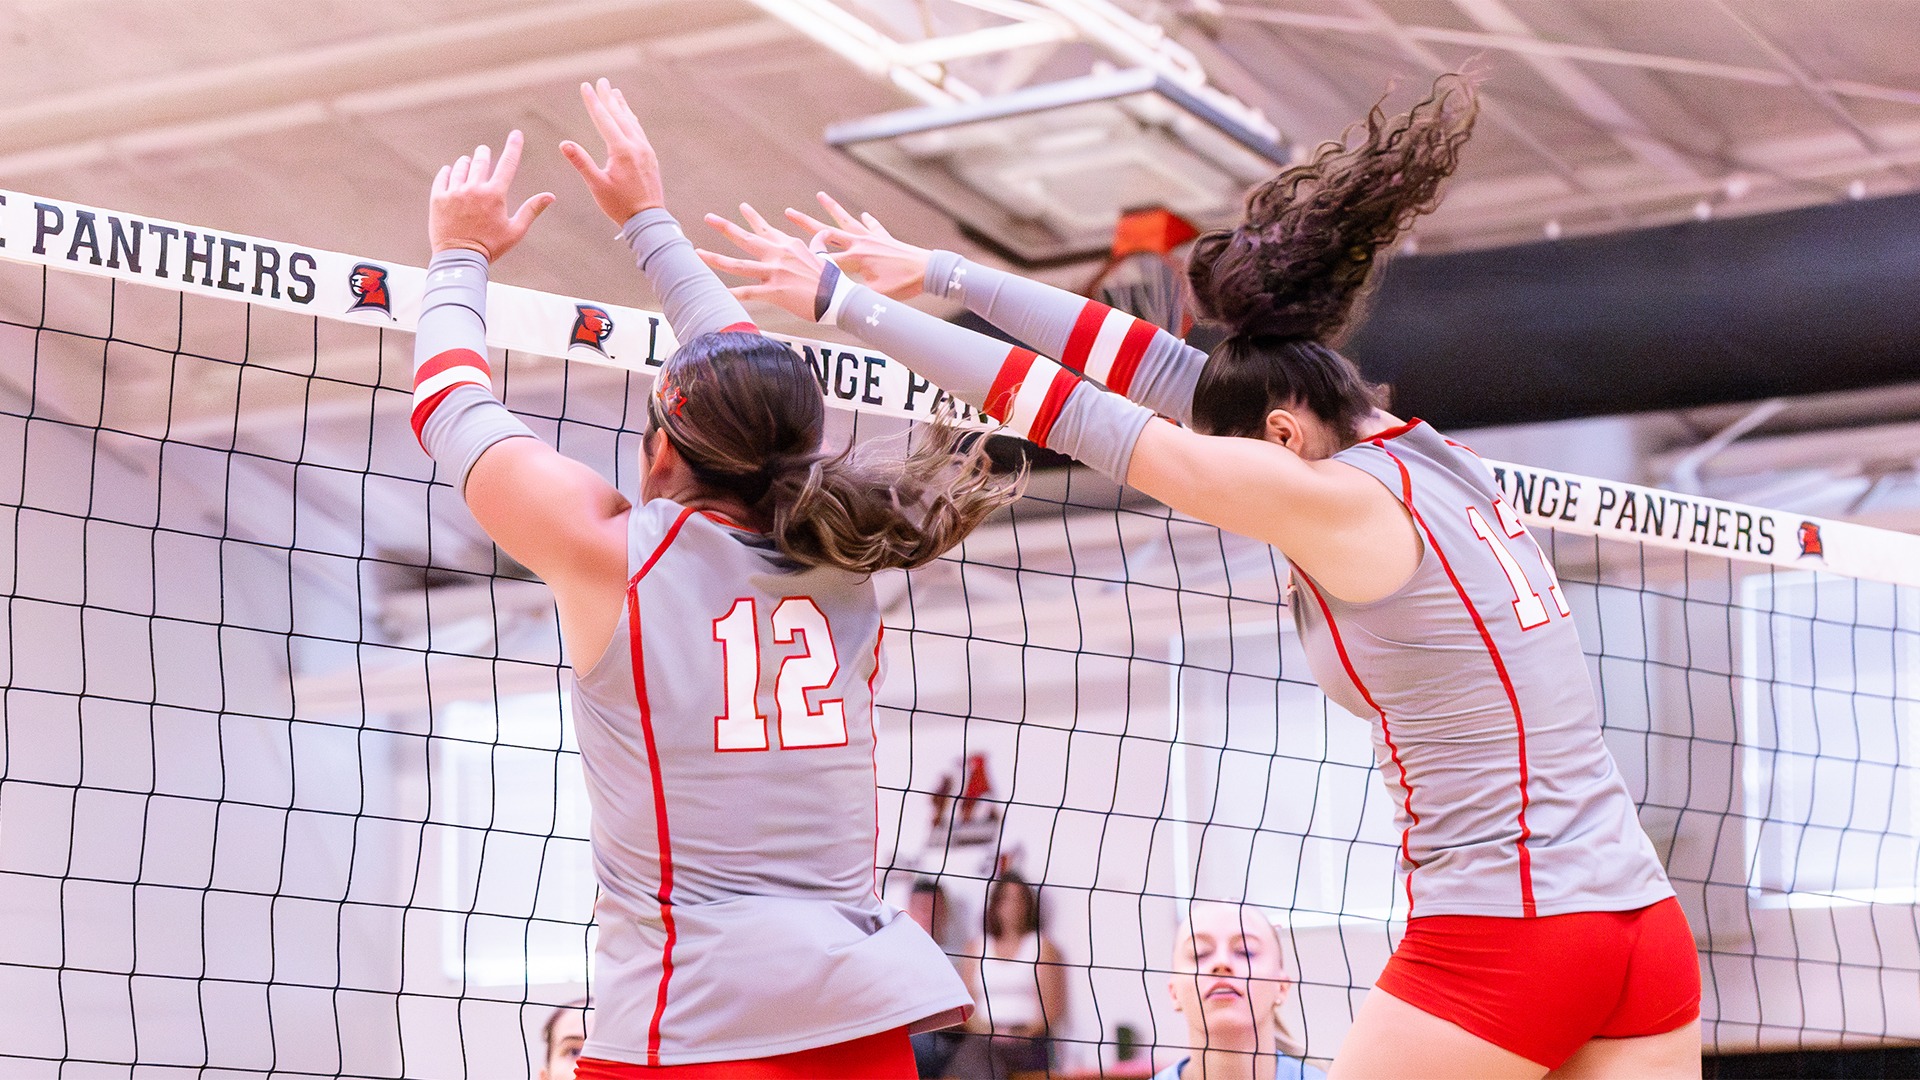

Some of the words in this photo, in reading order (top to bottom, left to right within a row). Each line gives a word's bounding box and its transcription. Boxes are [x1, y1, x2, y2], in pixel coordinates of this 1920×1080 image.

[32, 201, 317, 305] PANTHERS
[645, 317, 887, 405] LNGE
[1593, 486, 1775, 556] PANTHERS
[712, 595, 849, 753] 12
